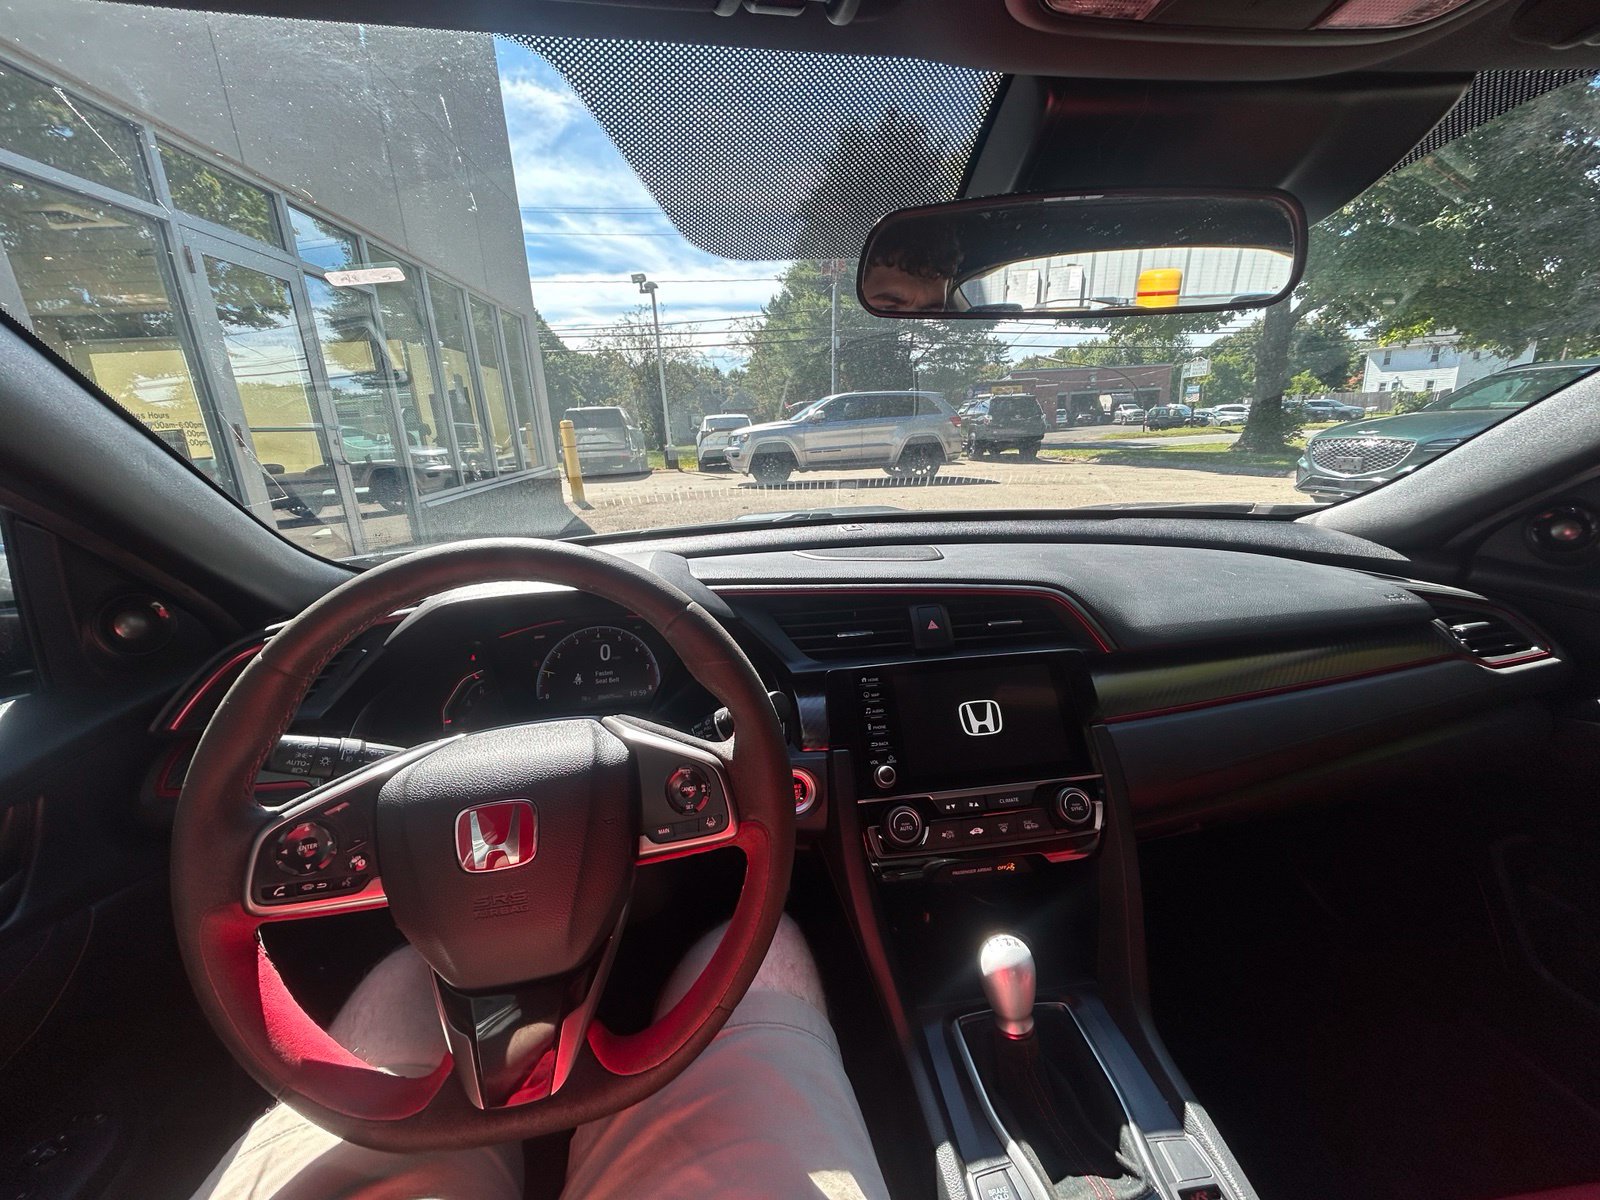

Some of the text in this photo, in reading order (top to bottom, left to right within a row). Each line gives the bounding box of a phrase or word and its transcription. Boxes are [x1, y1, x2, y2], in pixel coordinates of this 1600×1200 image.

[147, 411, 170, 419] Hours
[600, 644, 611, 661] 0
[287, 759, 307, 767] AUTO
[298, 843, 318, 852] ENTER
[988, 1186, 1008, 1196] BRAKE
